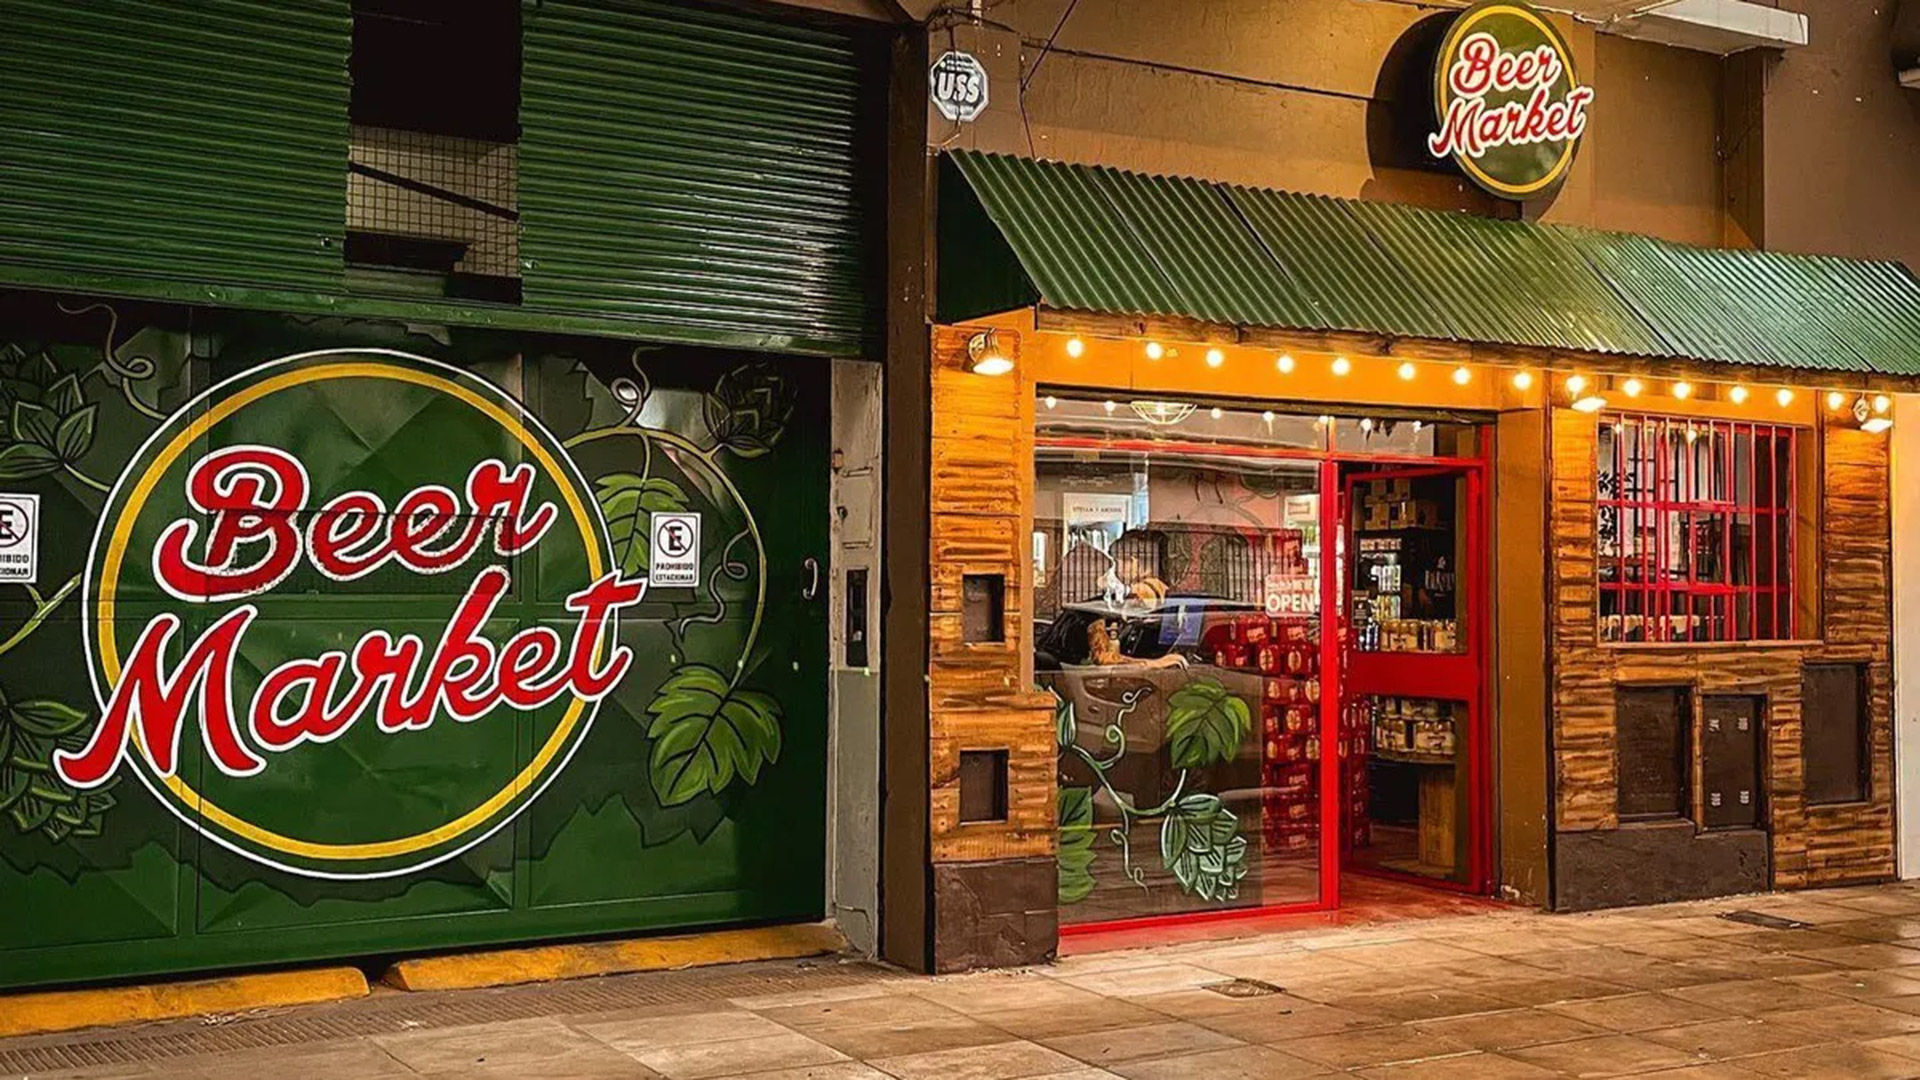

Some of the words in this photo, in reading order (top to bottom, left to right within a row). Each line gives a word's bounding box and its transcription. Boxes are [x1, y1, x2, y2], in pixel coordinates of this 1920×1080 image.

[937, 72, 981, 103] USS
[1450, 31, 1562, 99] Beer
[1427, 86, 1595, 158] Market
[152, 444, 558, 602] Beer
[1266, 593, 1316, 612] OPEN
[53, 565, 649, 789] Market
